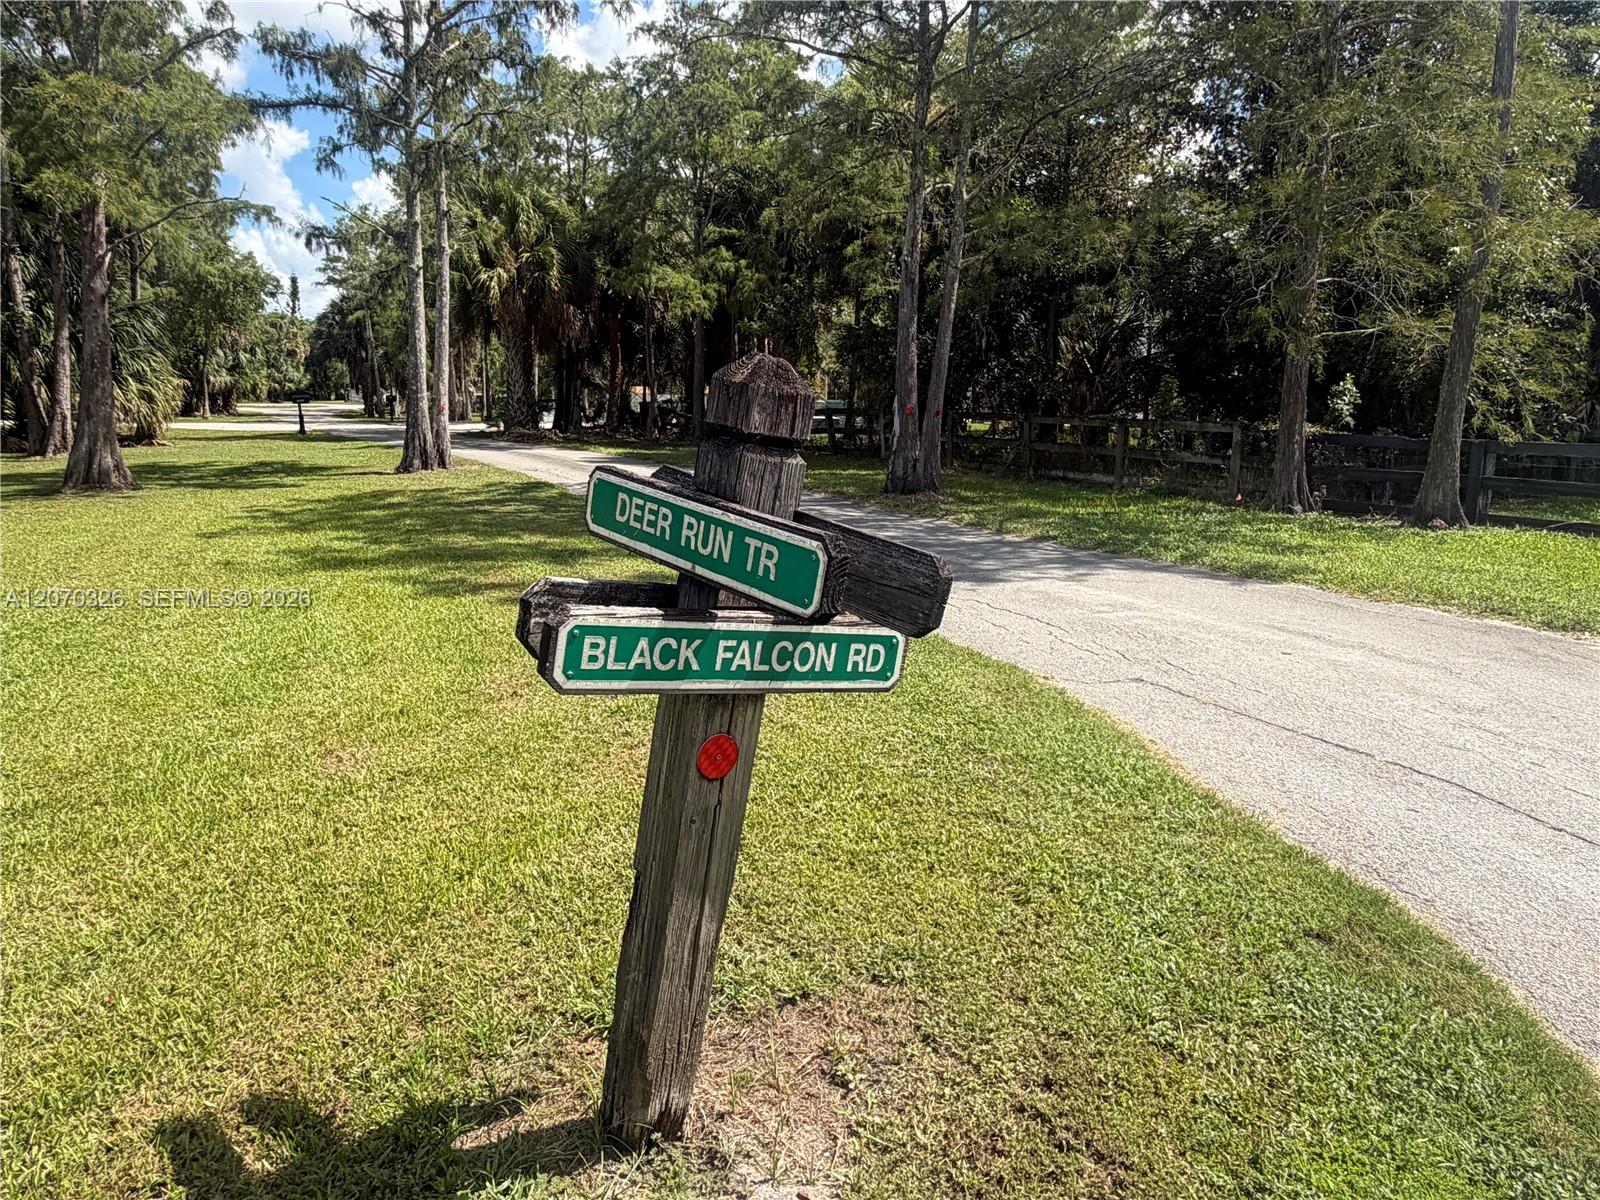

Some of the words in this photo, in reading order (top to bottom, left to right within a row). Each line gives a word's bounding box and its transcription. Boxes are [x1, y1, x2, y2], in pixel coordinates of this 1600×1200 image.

[616, 493, 671, 541] DEER
[682, 515, 734, 563] RUN
[745, 536, 780, 582] TR
[580, 635, 702, 672] BLACK
[715, 639, 838, 673] FALCON
[847, 643, 886, 673] RD
